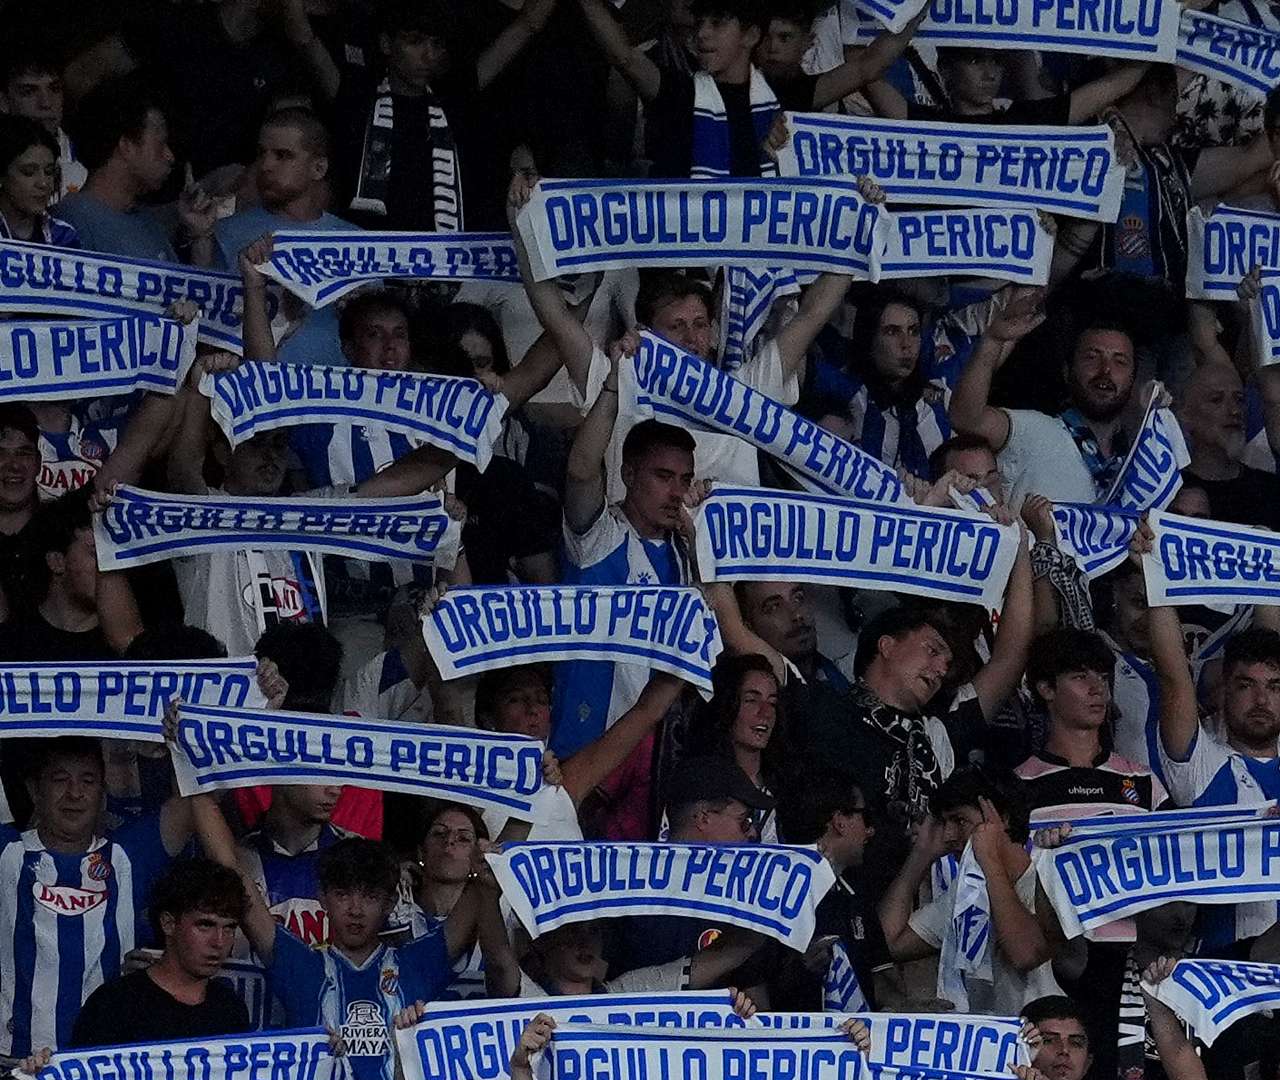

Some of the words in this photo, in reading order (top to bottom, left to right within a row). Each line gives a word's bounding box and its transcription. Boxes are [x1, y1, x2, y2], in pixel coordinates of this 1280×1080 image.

[792, 130, 962, 181] ORGULLO
[977, 145, 1111, 195] PERICO
[546, 191, 727, 251] ORGULLO
[742, 191, 874, 253] PERICO
[902, 212, 1035, 261] PERICO
[53, 318, 183, 376] PERICO
[380, 372, 491, 436] PERICO
[635, 341, 786, 442] ORGULLO
[707, 504, 856, 562] ORGULLO
[869, 514, 999, 581] PERICO
[431, 589, 597, 654] ORGULLO
[177, 718, 375, 769] ORGULLO
[392, 739, 542, 794] PERICO
[1068, 786, 1105, 797] uhlsport
[519, 846, 672, 901] ORGULLO
[684, 846, 811, 916] PERICO
[1056, 821, 1244, 905] ORGULLO
[39, 885, 96, 911] DANI
[341, 1026, 388, 1039] RIVIERA
